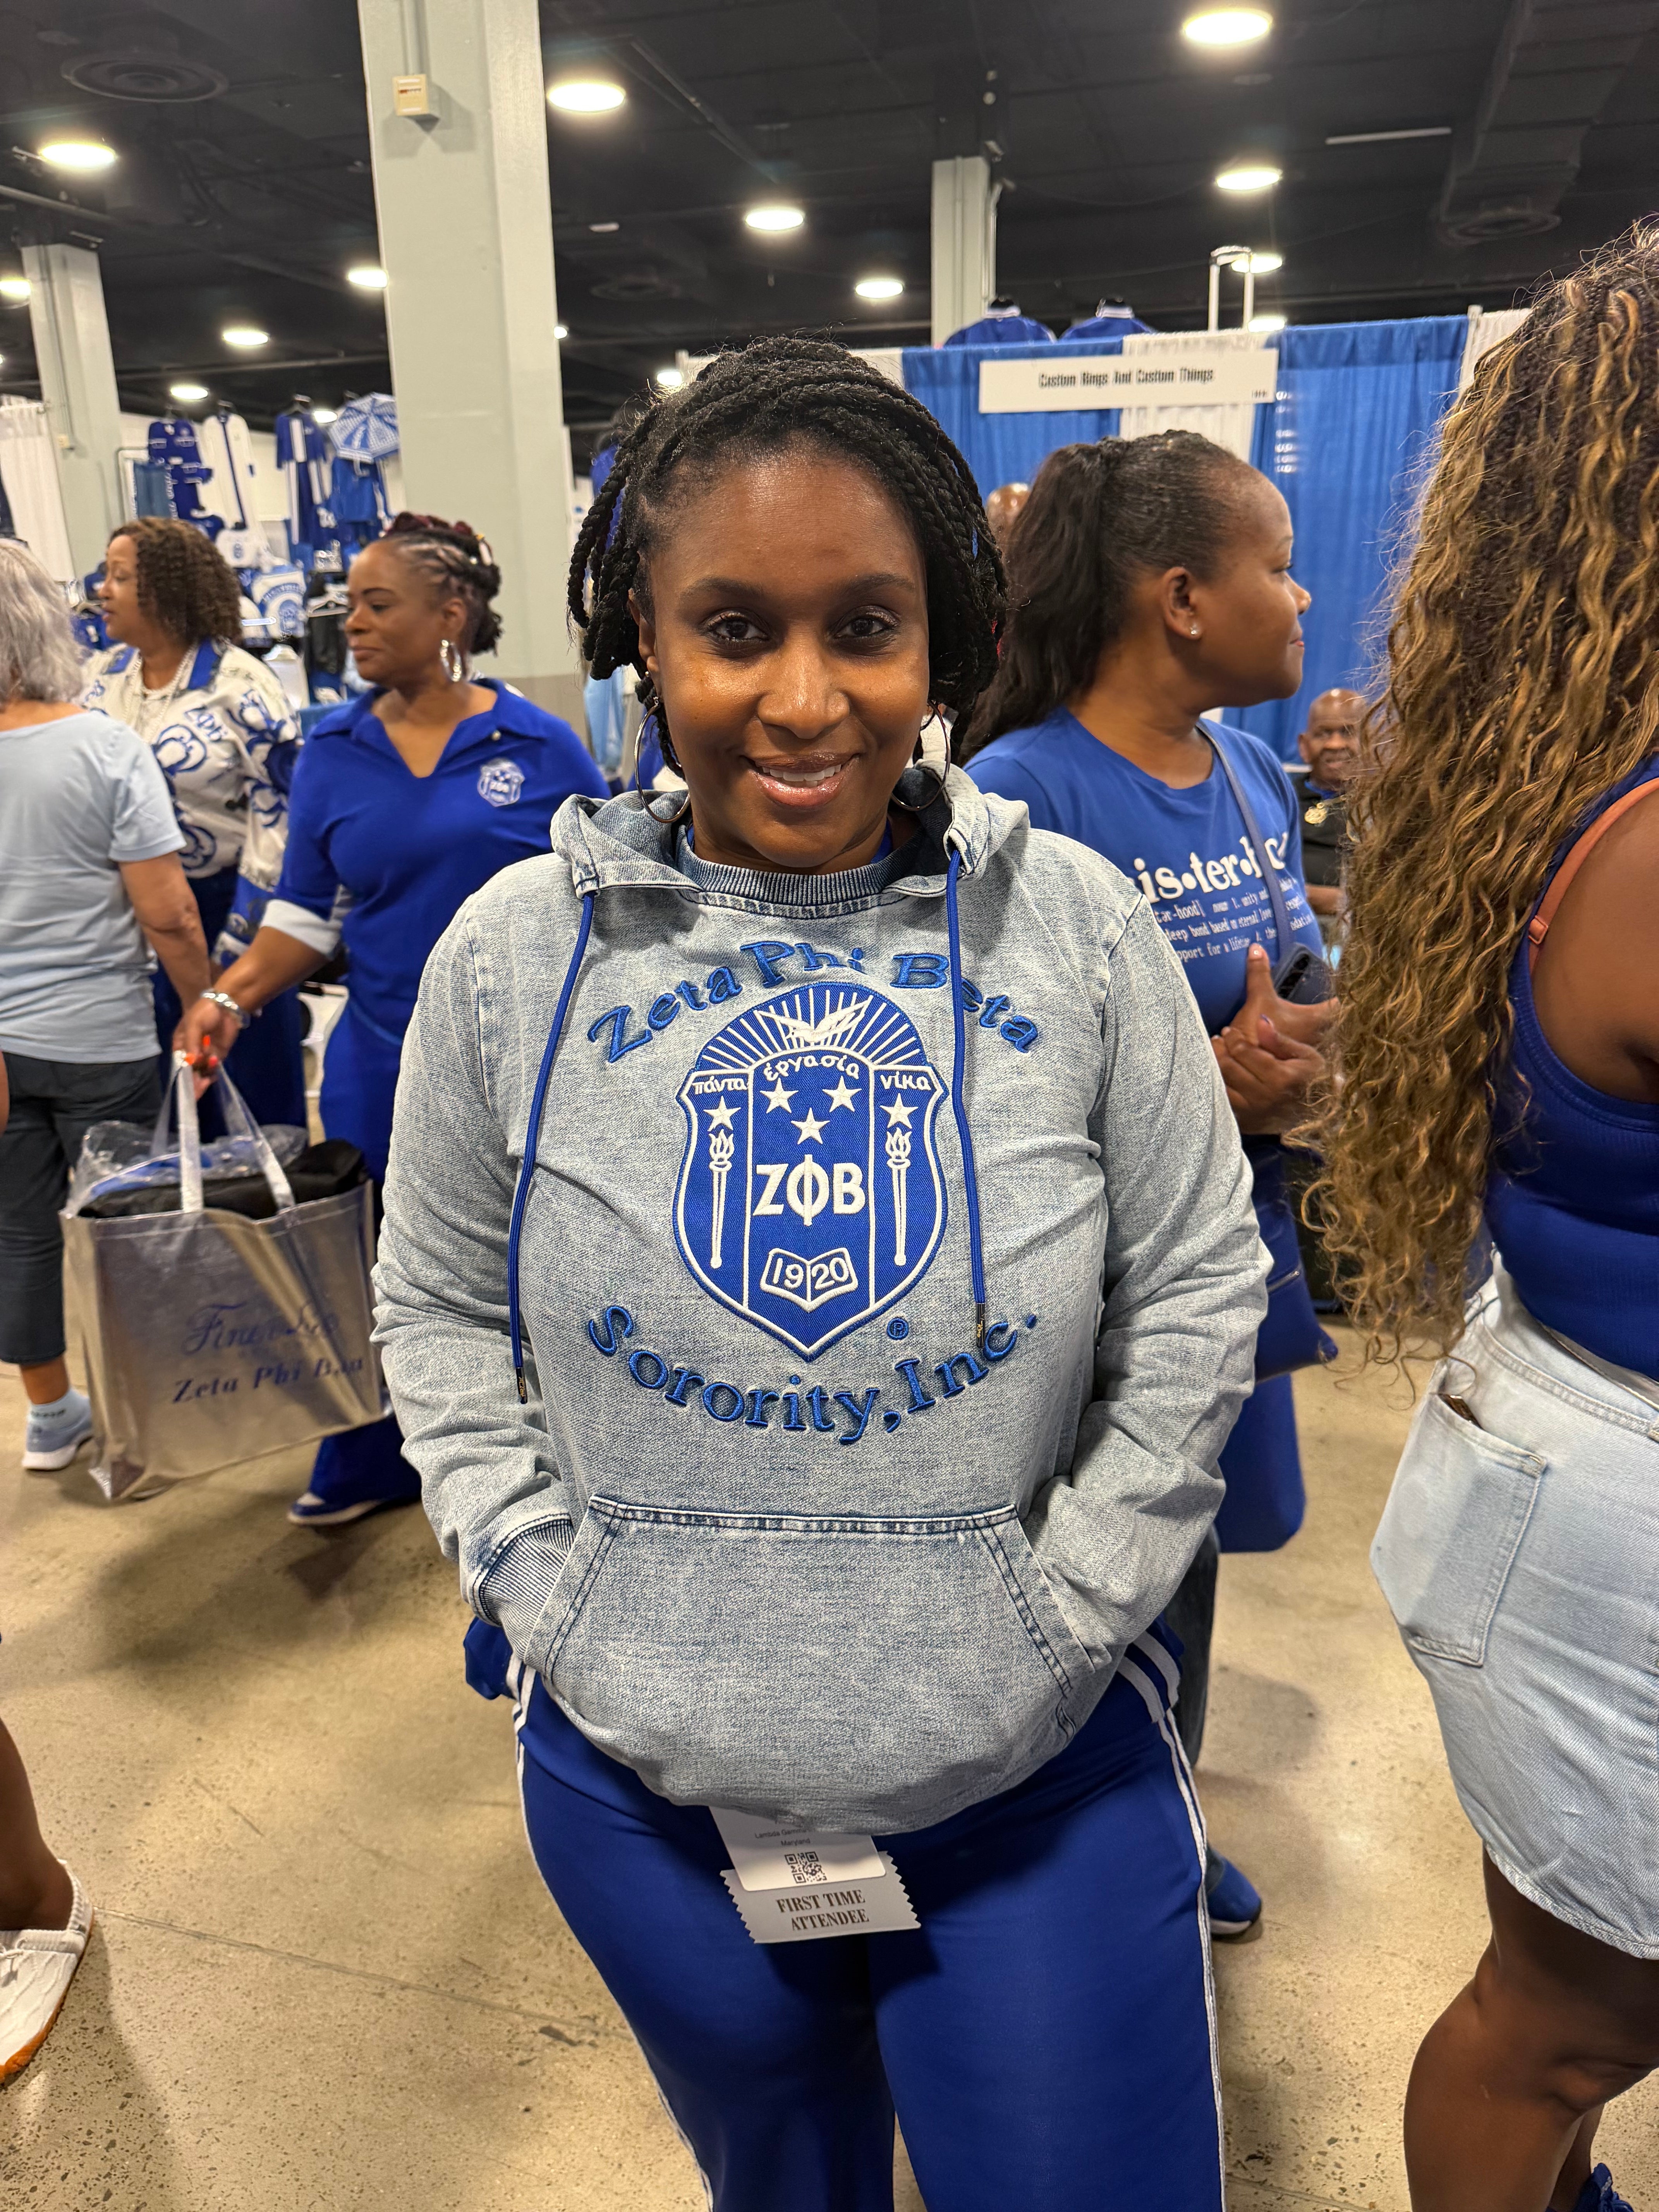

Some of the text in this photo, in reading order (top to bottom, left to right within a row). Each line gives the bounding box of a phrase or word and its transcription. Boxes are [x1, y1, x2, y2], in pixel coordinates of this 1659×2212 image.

[587, 941, 1038, 1064] Zeta Phi Beta
[772, 1257, 850, 1290] 1920
[173, 1377, 239, 1403] Zeta
[781, 1838, 811, 1846] Maryland
[776, 1889, 866, 1913] FIRST TIME
[791, 1908, 870, 1931] ATTENDEE
